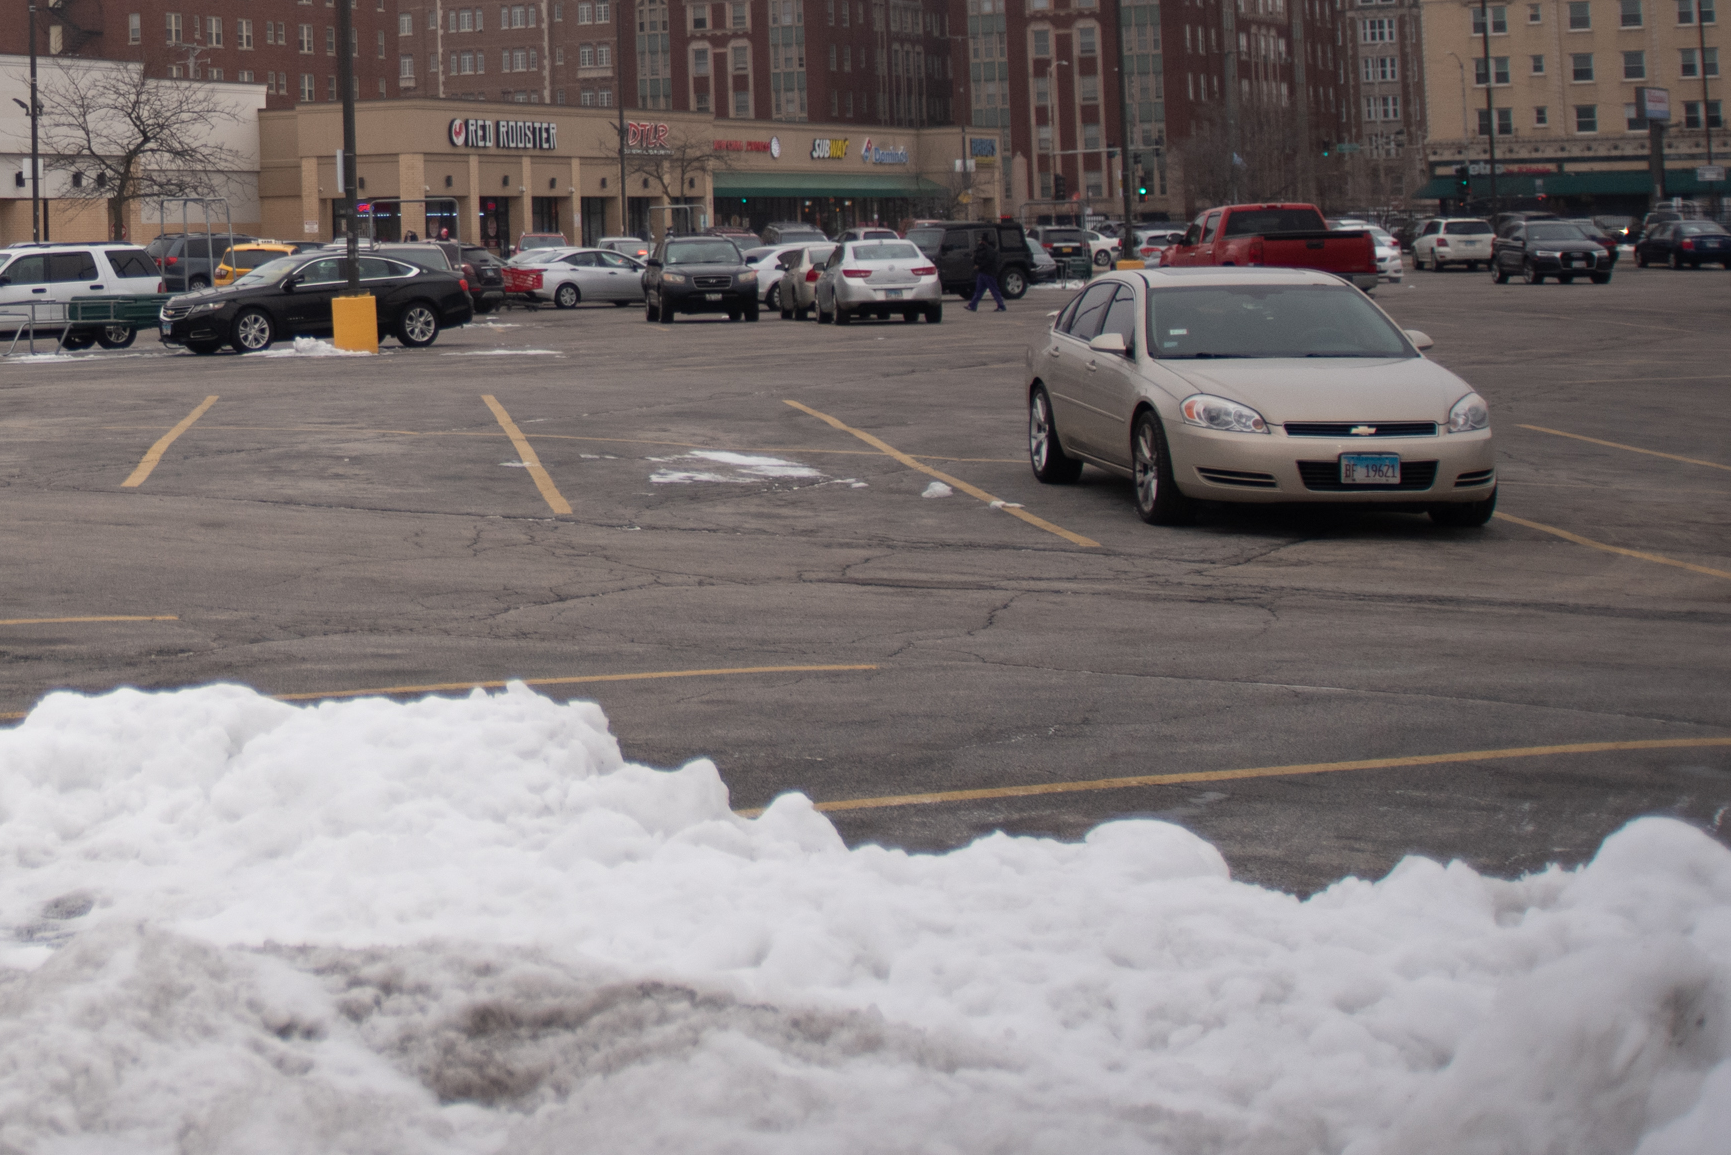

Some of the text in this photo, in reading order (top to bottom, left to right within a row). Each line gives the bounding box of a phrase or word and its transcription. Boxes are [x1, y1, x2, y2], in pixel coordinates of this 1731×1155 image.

[466, 119, 557, 149] RED ROOSTER
[627, 120, 670, 148] DTLR
[811, 138, 850, 159] SUBWAY
[1345, 463, 1397, 478] BF 19621
